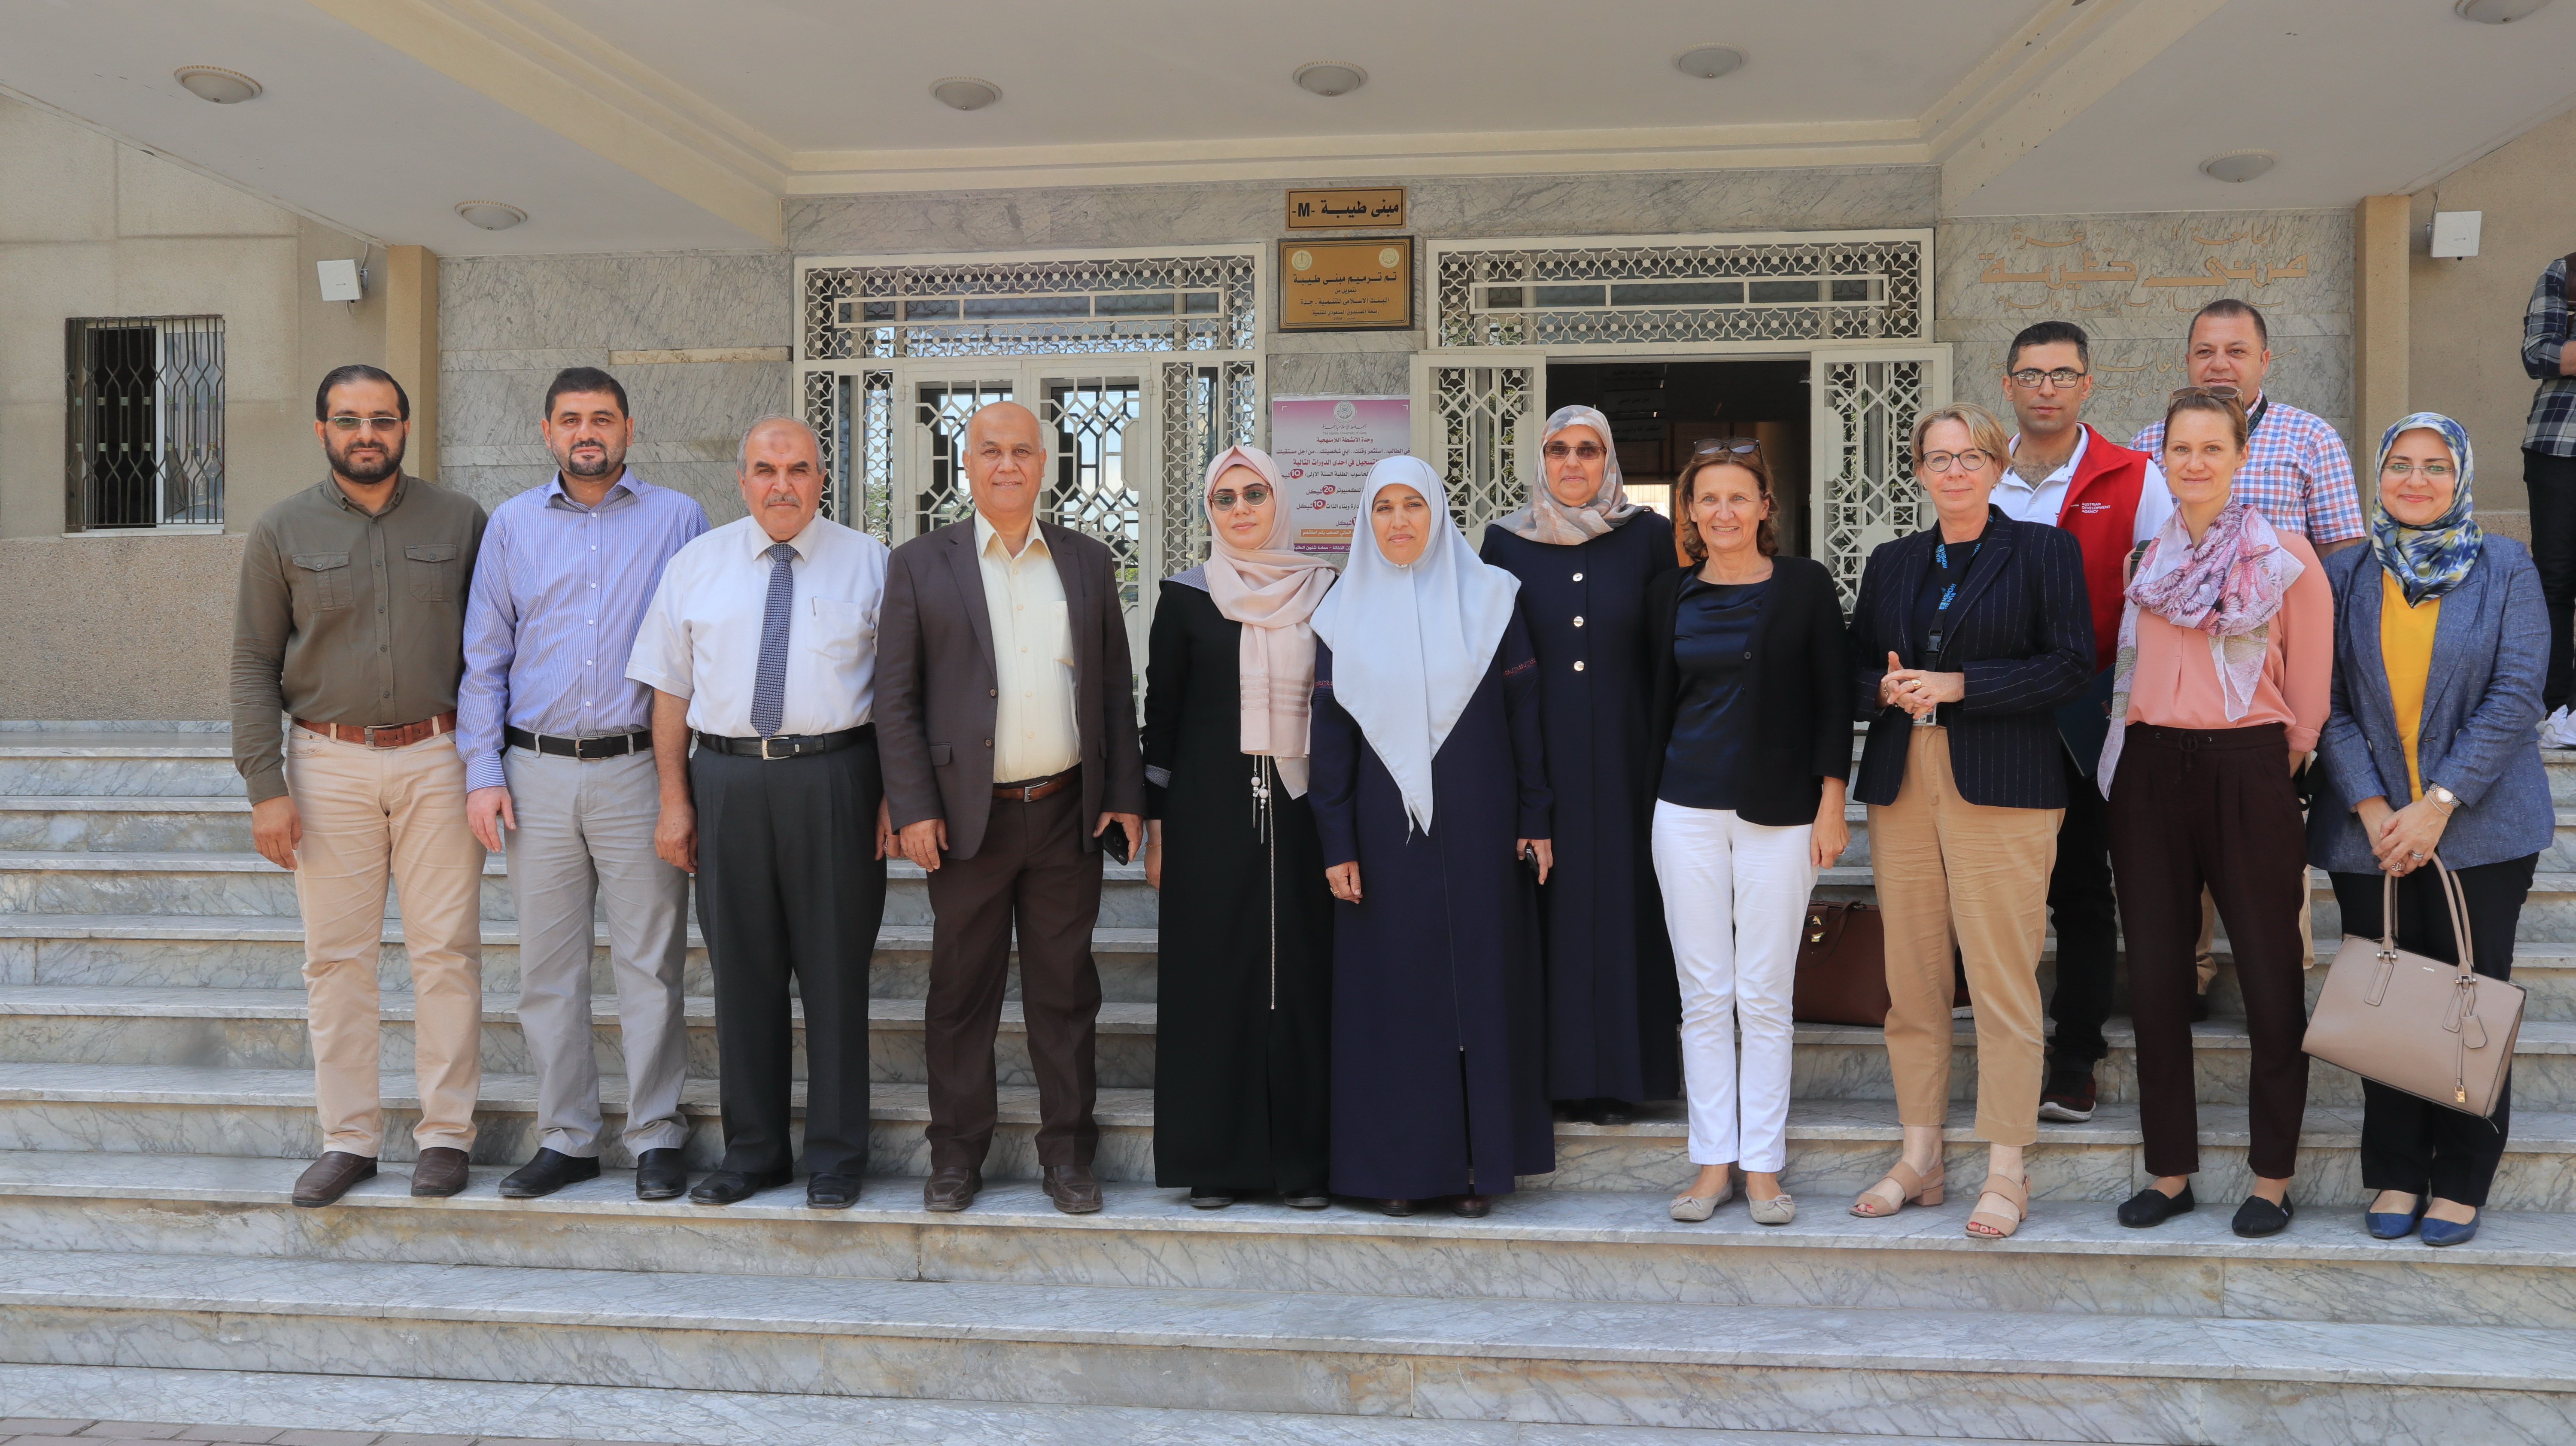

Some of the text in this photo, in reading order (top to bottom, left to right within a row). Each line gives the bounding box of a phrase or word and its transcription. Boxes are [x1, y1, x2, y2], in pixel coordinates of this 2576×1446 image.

[1321, 199, 1367, 219] طيبة
[1371, 199, 1399, 218] مبنى
[1293, 271, 1397, 286] تم ترميم مبنى طيبة
[1293, 459, 1311, 467] التالية
[1348, 459, 1355, 467] في
[1942, 583, 1957, 602] WOMEN
